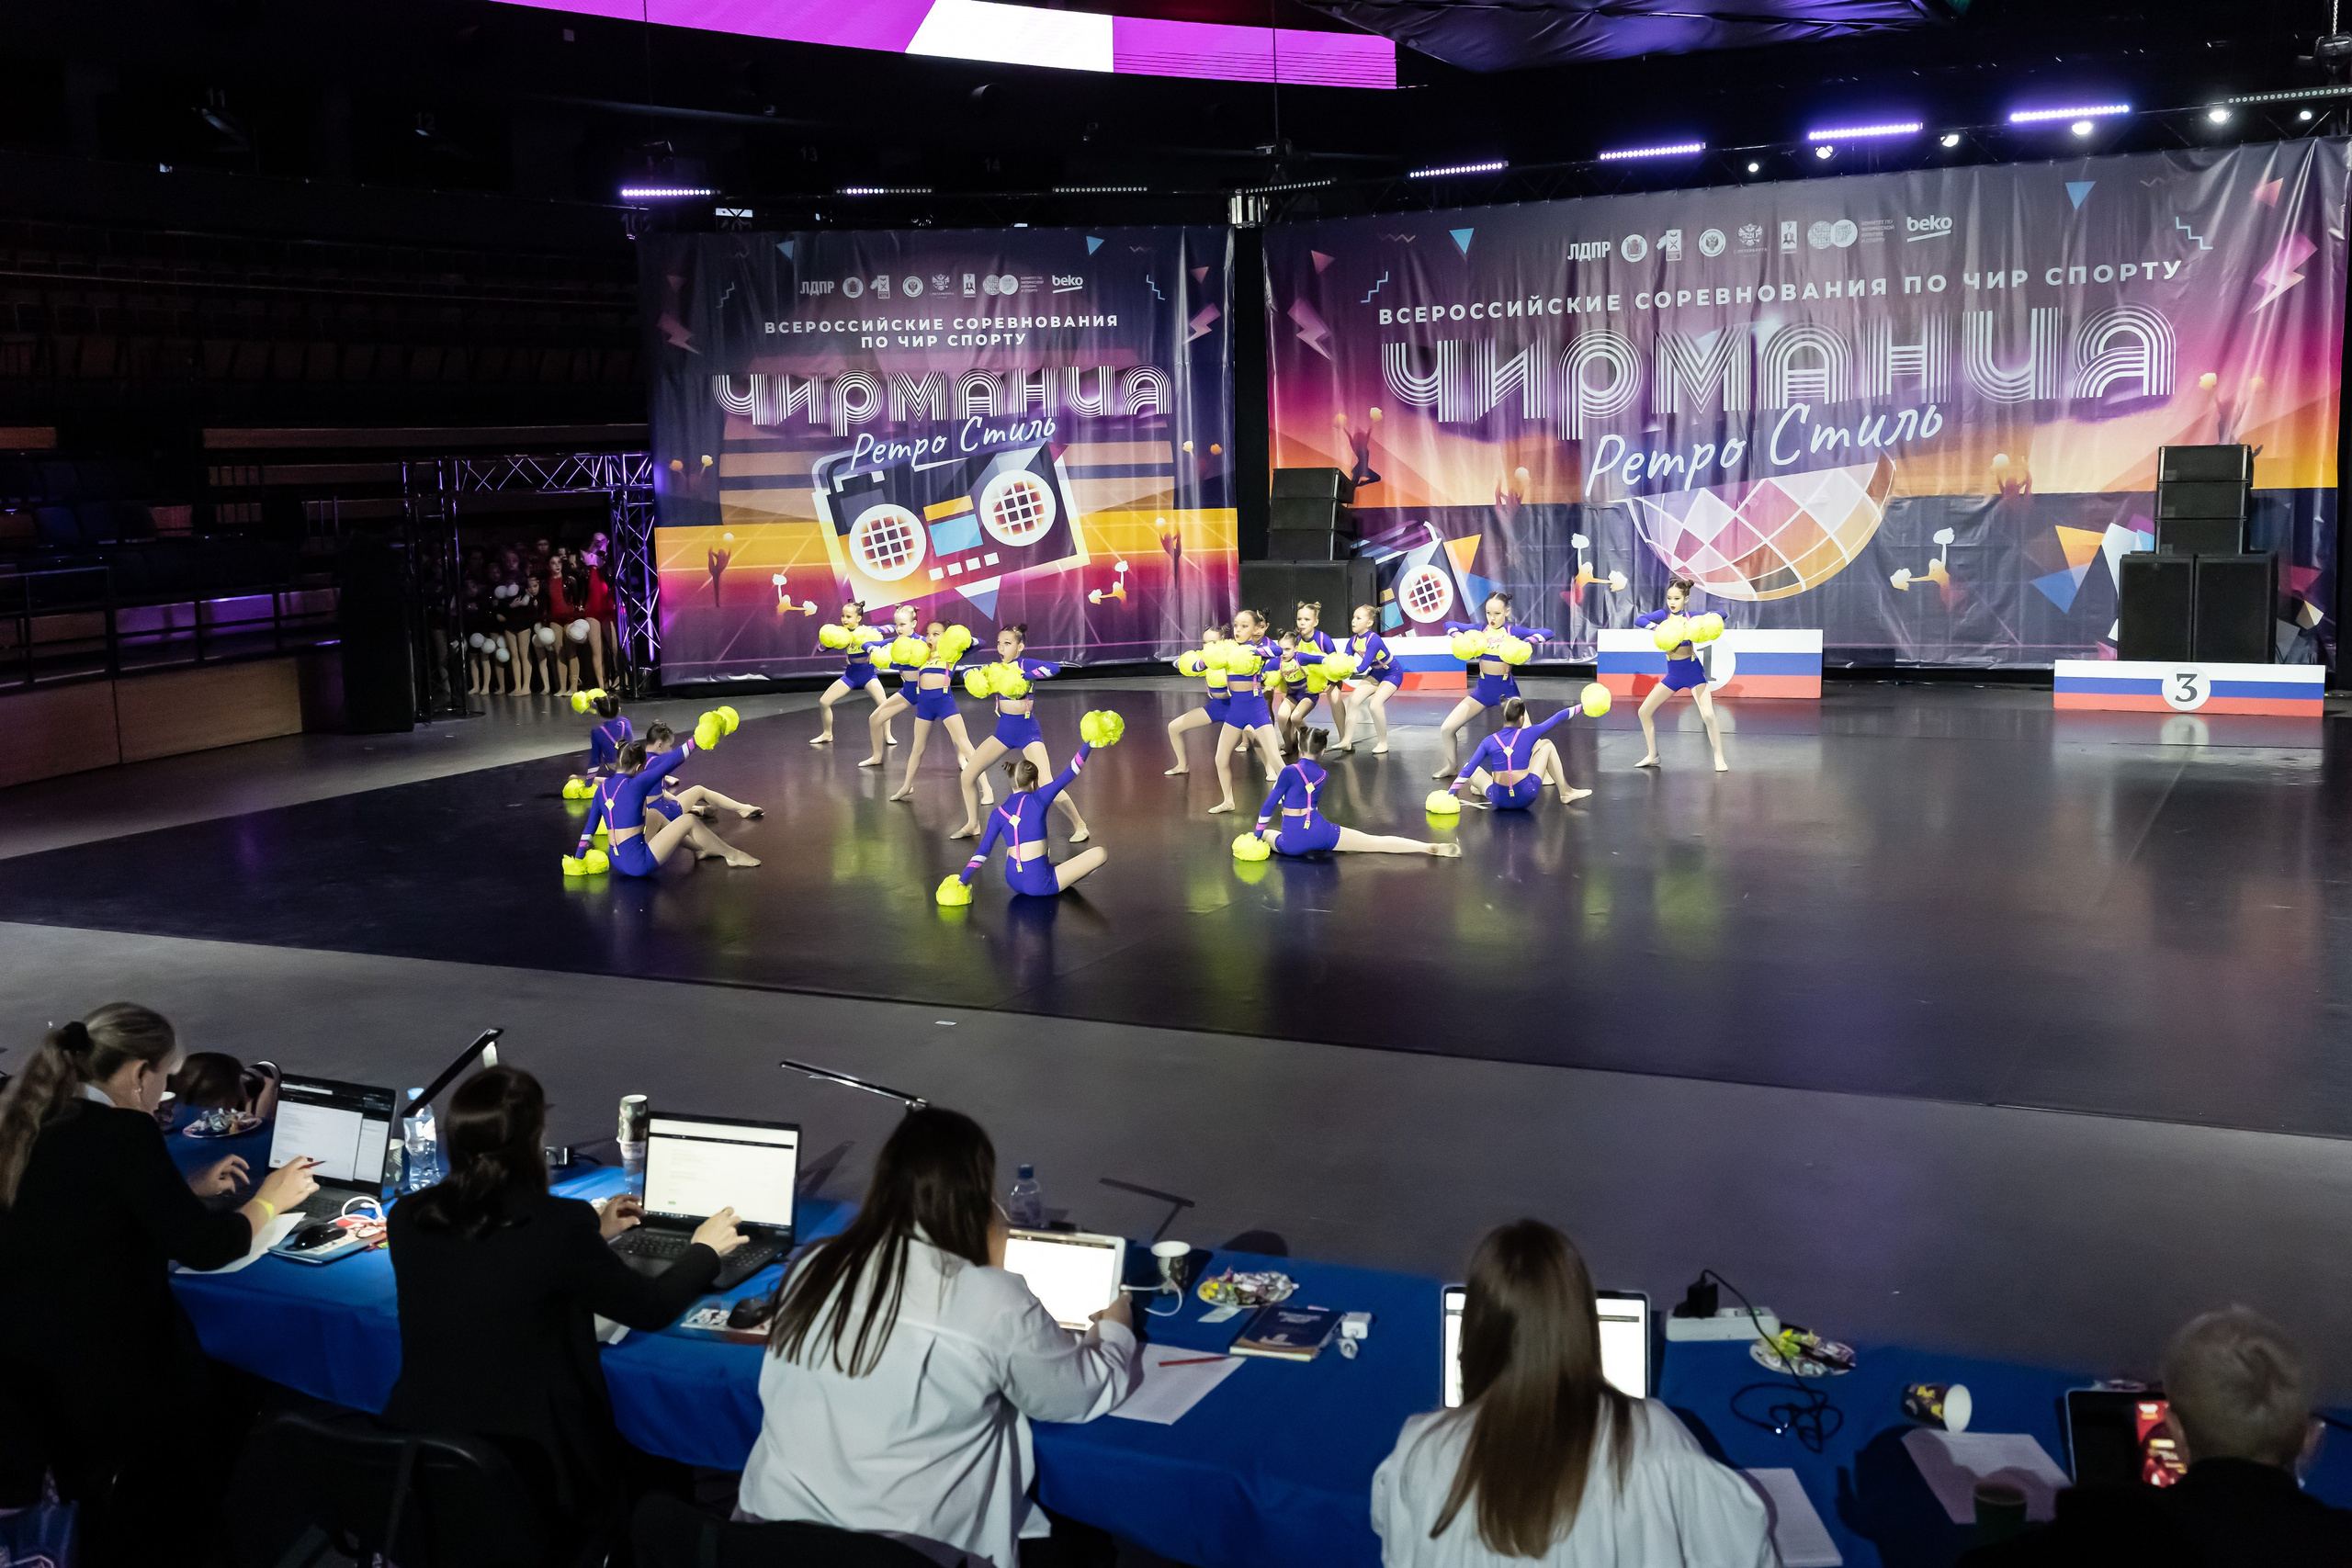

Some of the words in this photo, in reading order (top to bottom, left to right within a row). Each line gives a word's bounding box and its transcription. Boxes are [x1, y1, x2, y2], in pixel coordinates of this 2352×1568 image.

[1906, 215, 1952, 231] beko
[1567, 242, 1611, 262] ЛДПР
[800, 281, 834, 296] ЛДПР
[1052, 275, 1083, 286] beko
[1379, 294, 1620, 325] ВСЕРОССИЙСКИЕ
[1635, 277, 1886, 310] СОРЕВНОВАНИЯ
[1905, 275, 1947, 294] ПО
[1963, 270, 2028, 290] ЧИР
[2045, 260, 2182, 286] СПОРТУ
[764, 317, 944, 334] ВСЕРОССИЙСКИЕ
[953, 314, 1118, 331] СОРЕВНОВАНИЯ
[861, 335, 888, 349] ПО
[898, 334, 937, 348] ЧИР
[947, 333, 1027, 347] СПОРТУ
[851, 433, 948, 471] Ретро
[960, 415, 1057, 451] Стиль
[1585, 434, 1747, 497] Ретро
[1770, 402, 1943, 466] Стиль
[1697, 645, 1716, 681] 1
[2175, 673, 2198, 702] 3
